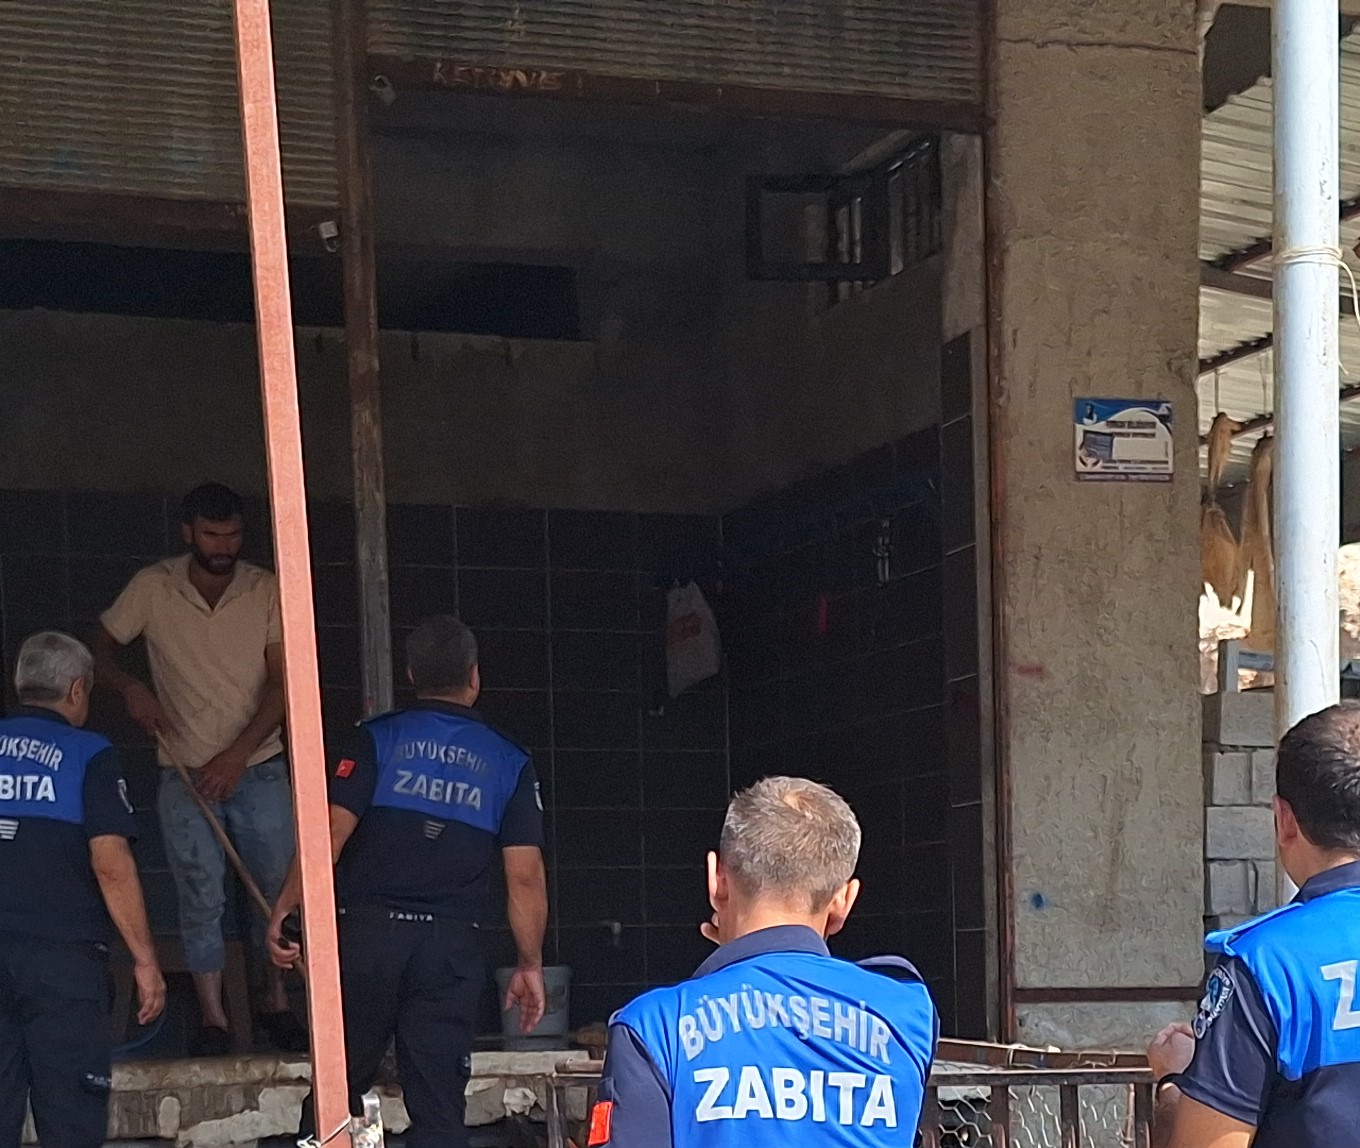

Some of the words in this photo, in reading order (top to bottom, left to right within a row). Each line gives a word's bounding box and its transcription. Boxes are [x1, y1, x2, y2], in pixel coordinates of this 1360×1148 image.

[393, 769, 482, 811] ZABITA
[678, 983, 893, 1065] BÜYÜKŞEHİR
[692, 1065, 899, 1128] ZABITA
